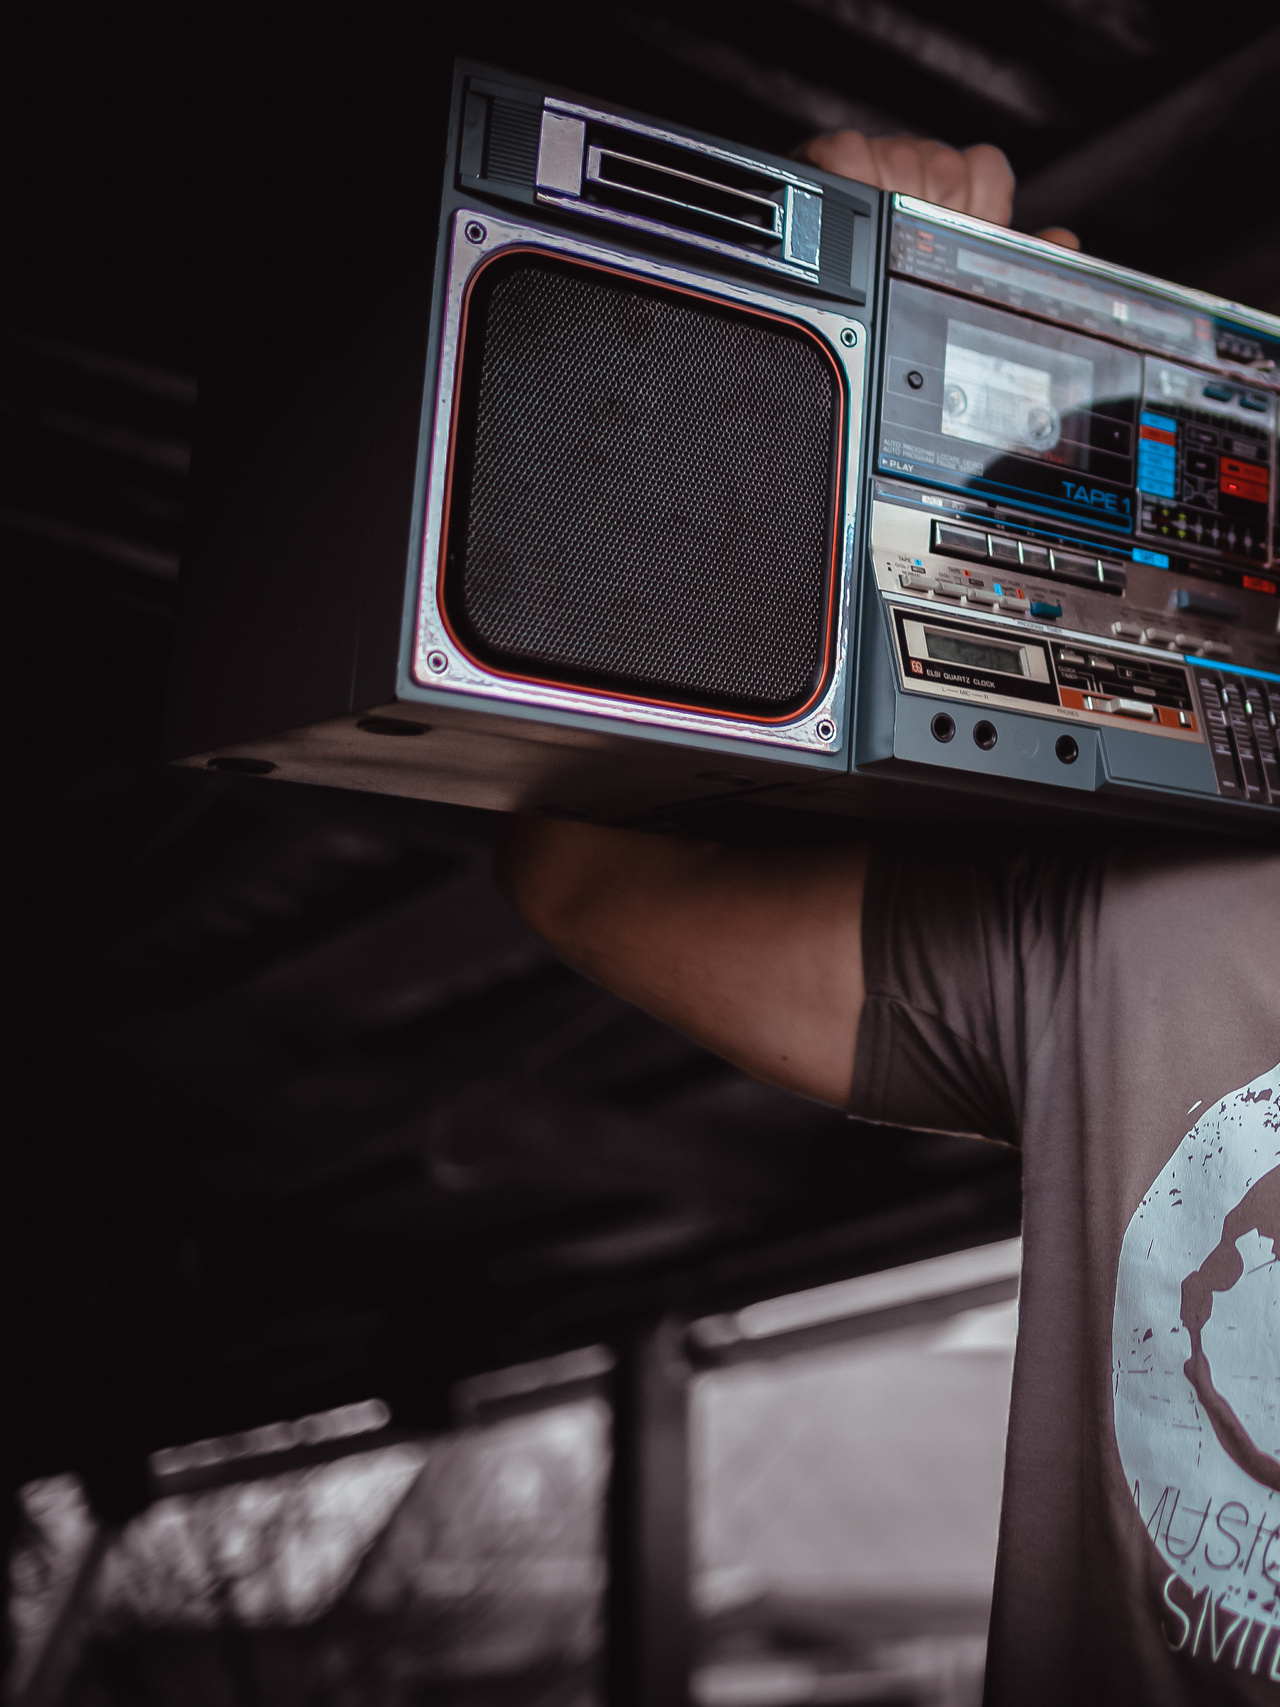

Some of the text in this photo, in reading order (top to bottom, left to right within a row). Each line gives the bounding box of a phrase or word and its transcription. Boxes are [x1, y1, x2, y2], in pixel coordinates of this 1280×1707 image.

[889, 459, 914, 473] PLAY
[1062, 481, 1118, 512] TAPE
[1122, 498, 1131, 515] 1
[943, 672, 971, 685] QUARTZ
[973, 678, 996, 689] CLOCK
